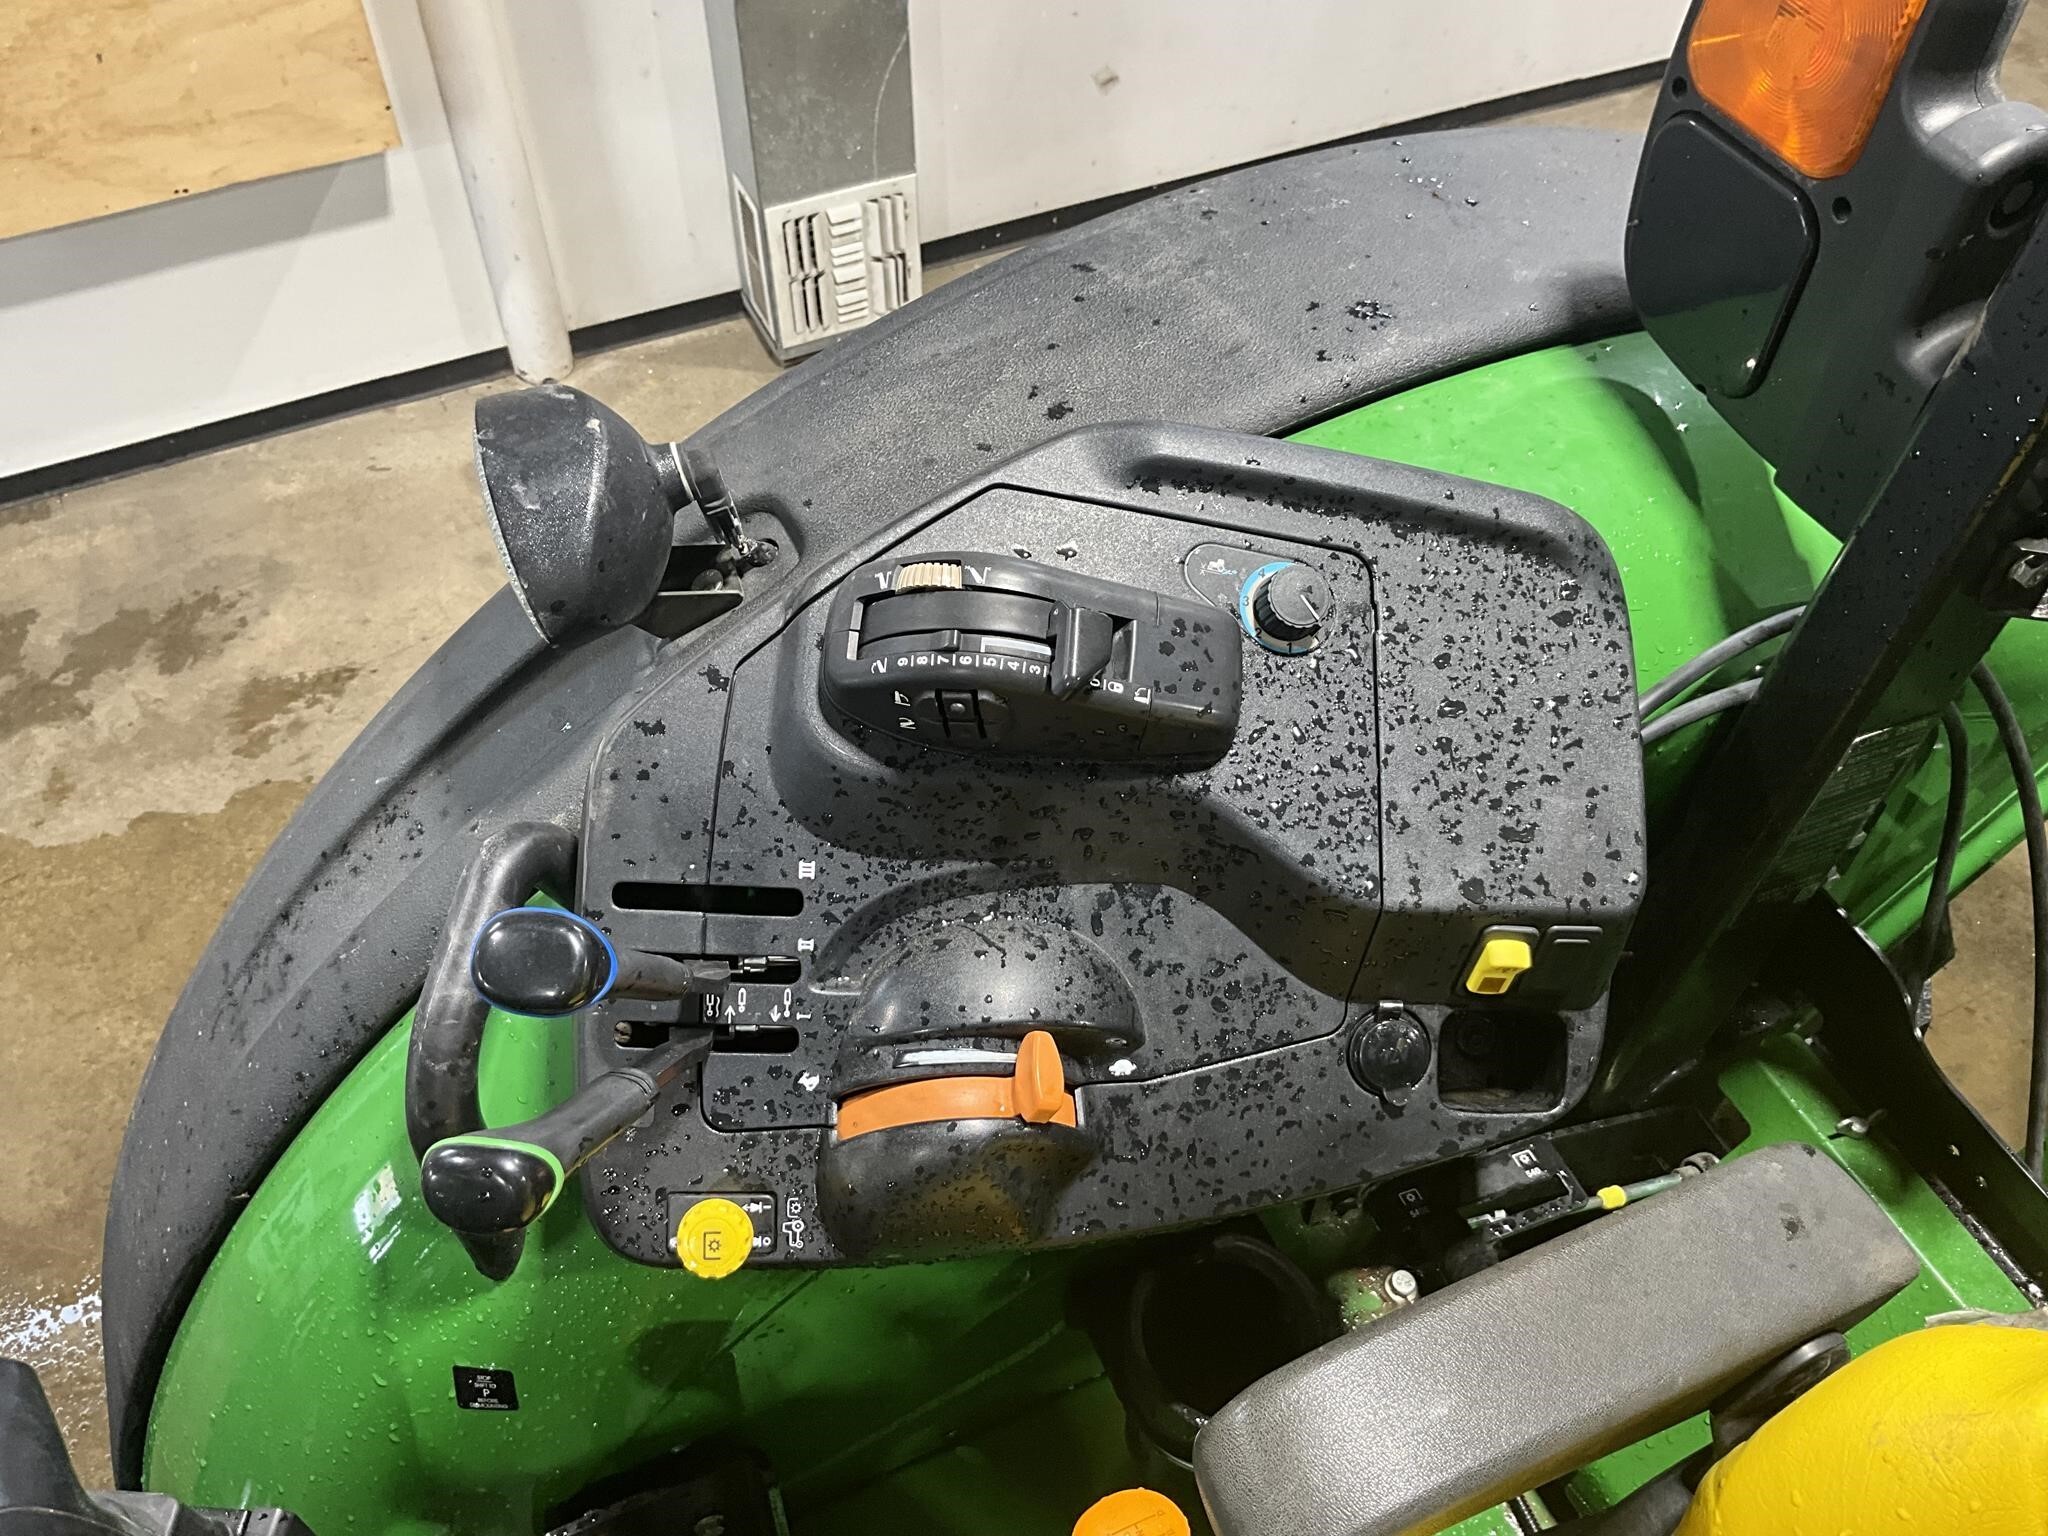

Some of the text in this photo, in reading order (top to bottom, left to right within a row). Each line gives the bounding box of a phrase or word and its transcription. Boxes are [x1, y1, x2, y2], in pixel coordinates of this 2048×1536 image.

[1258, 568, 1265, 578] 4
[1242, 596, 1249, 606] 3
[1255, 627, 1262, 638] 2
[1286, 642, 1292, 653] 1
[897, 657, 908, 667] 9
[916, 656, 928, 665] 8
[937, 656, 950, 664] 7
[959, 655, 973, 665] 6
[983, 657, 997, 666] 5
[1007, 661, 1020, 670] 4
[1029, 664, 1041, 675] 3
[483, 1388, 490, 1397] P
